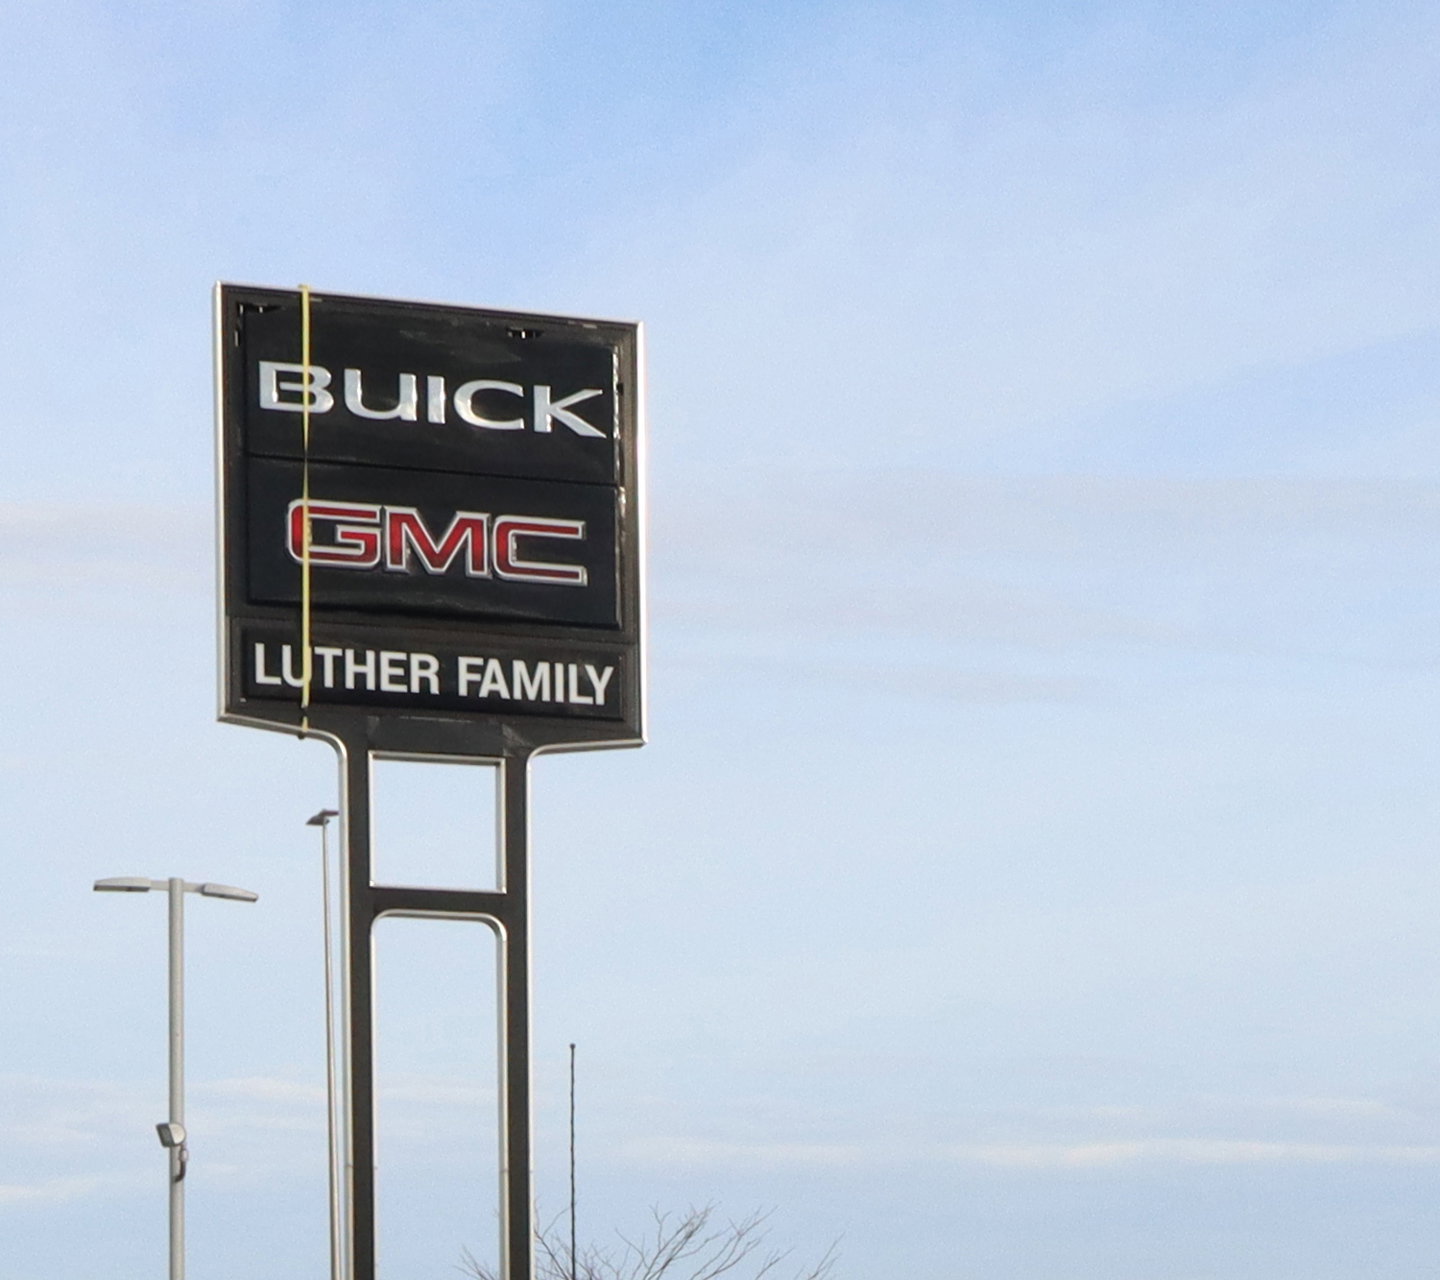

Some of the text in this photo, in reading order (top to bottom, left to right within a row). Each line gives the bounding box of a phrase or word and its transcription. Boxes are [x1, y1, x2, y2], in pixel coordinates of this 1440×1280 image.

[259, 361, 606, 438] BUICK
[287, 499, 588, 586] GMC
[254, 643, 614, 706] LUTHER FAMILY
